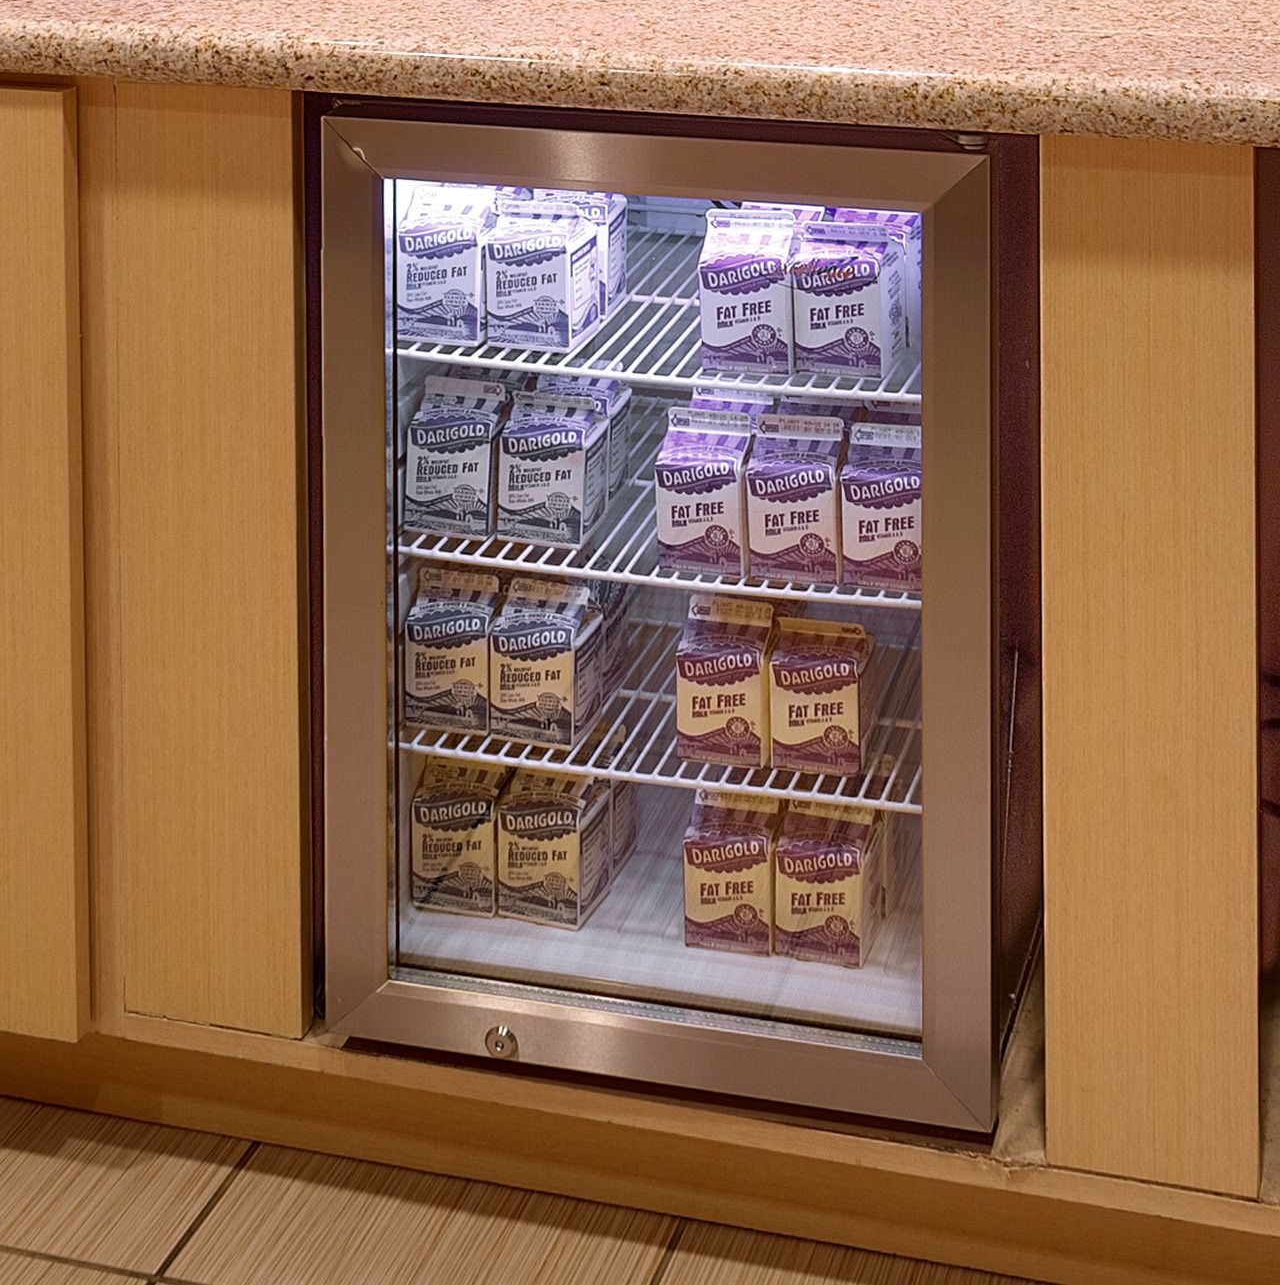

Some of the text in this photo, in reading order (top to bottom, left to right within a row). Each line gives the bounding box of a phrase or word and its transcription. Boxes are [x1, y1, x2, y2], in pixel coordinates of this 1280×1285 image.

[404, 227, 474, 252] DARIGOLD
[493, 235, 561, 259] DARIGOLD
[406, 263, 419, 272] 2%
[406, 268, 447, 283] REDUCED
[451, 266, 468, 277] FAT
[496, 270, 508, 280] 2%
[707, 260, 777, 288] DARIGOLD
[496, 275, 537, 290] REDUCED
[541, 272, 558, 284] FAT
[716, 299, 772, 321] FAT FREE
[810, 303, 865, 322] FAT FREE
[417, 424, 485, 445] DARIGOLD
[508, 431, 577, 453] DARIGOLD
[416, 462, 479, 476] REDUCED FAT
[417, 456, 430, 465] 2%
[509, 464, 521, 473] 2%
[508, 469, 572, 484] REDUCED FAT
[663, 462, 730, 486] DARIGOLD
[755, 470, 825, 495] DARIGOLD
[850, 476, 921, 500] DARIGOLD
[671, 501, 724, 519] FAT FREE
[764, 509, 820, 528] FAT FREE
[858, 516, 915, 534] FAT FREE
[413, 618, 481, 640] DARIGOLD
[498, 631, 567, 652] DARIGOLD
[415, 652, 427, 661] 2%
[415, 656, 476, 672] REDUCED FAT
[684, 653, 752, 677] DARIGOLD
[500, 663, 512, 672] 2%
[500, 669, 561, 683] REDUCED FAT
[781, 662, 849, 686] DARIGOLD
[692, 693, 746, 710] FAT FREE
[788, 702, 844, 719] FAT FREE
[420, 801, 487, 822] DARIGOLD
[506, 811, 572, 831] DARIGOLD
[422, 840, 482, 854] REDUCED FAT
[508, 849, 567, 862] REDUCED FAT
[692, 841, 760, 864] DARIGOLD
[784, 852, 852, 874] DARIGOLD
[700, 880, 754, 896] FAT FREE
[791, 891, 845, 907] FAT FREE
